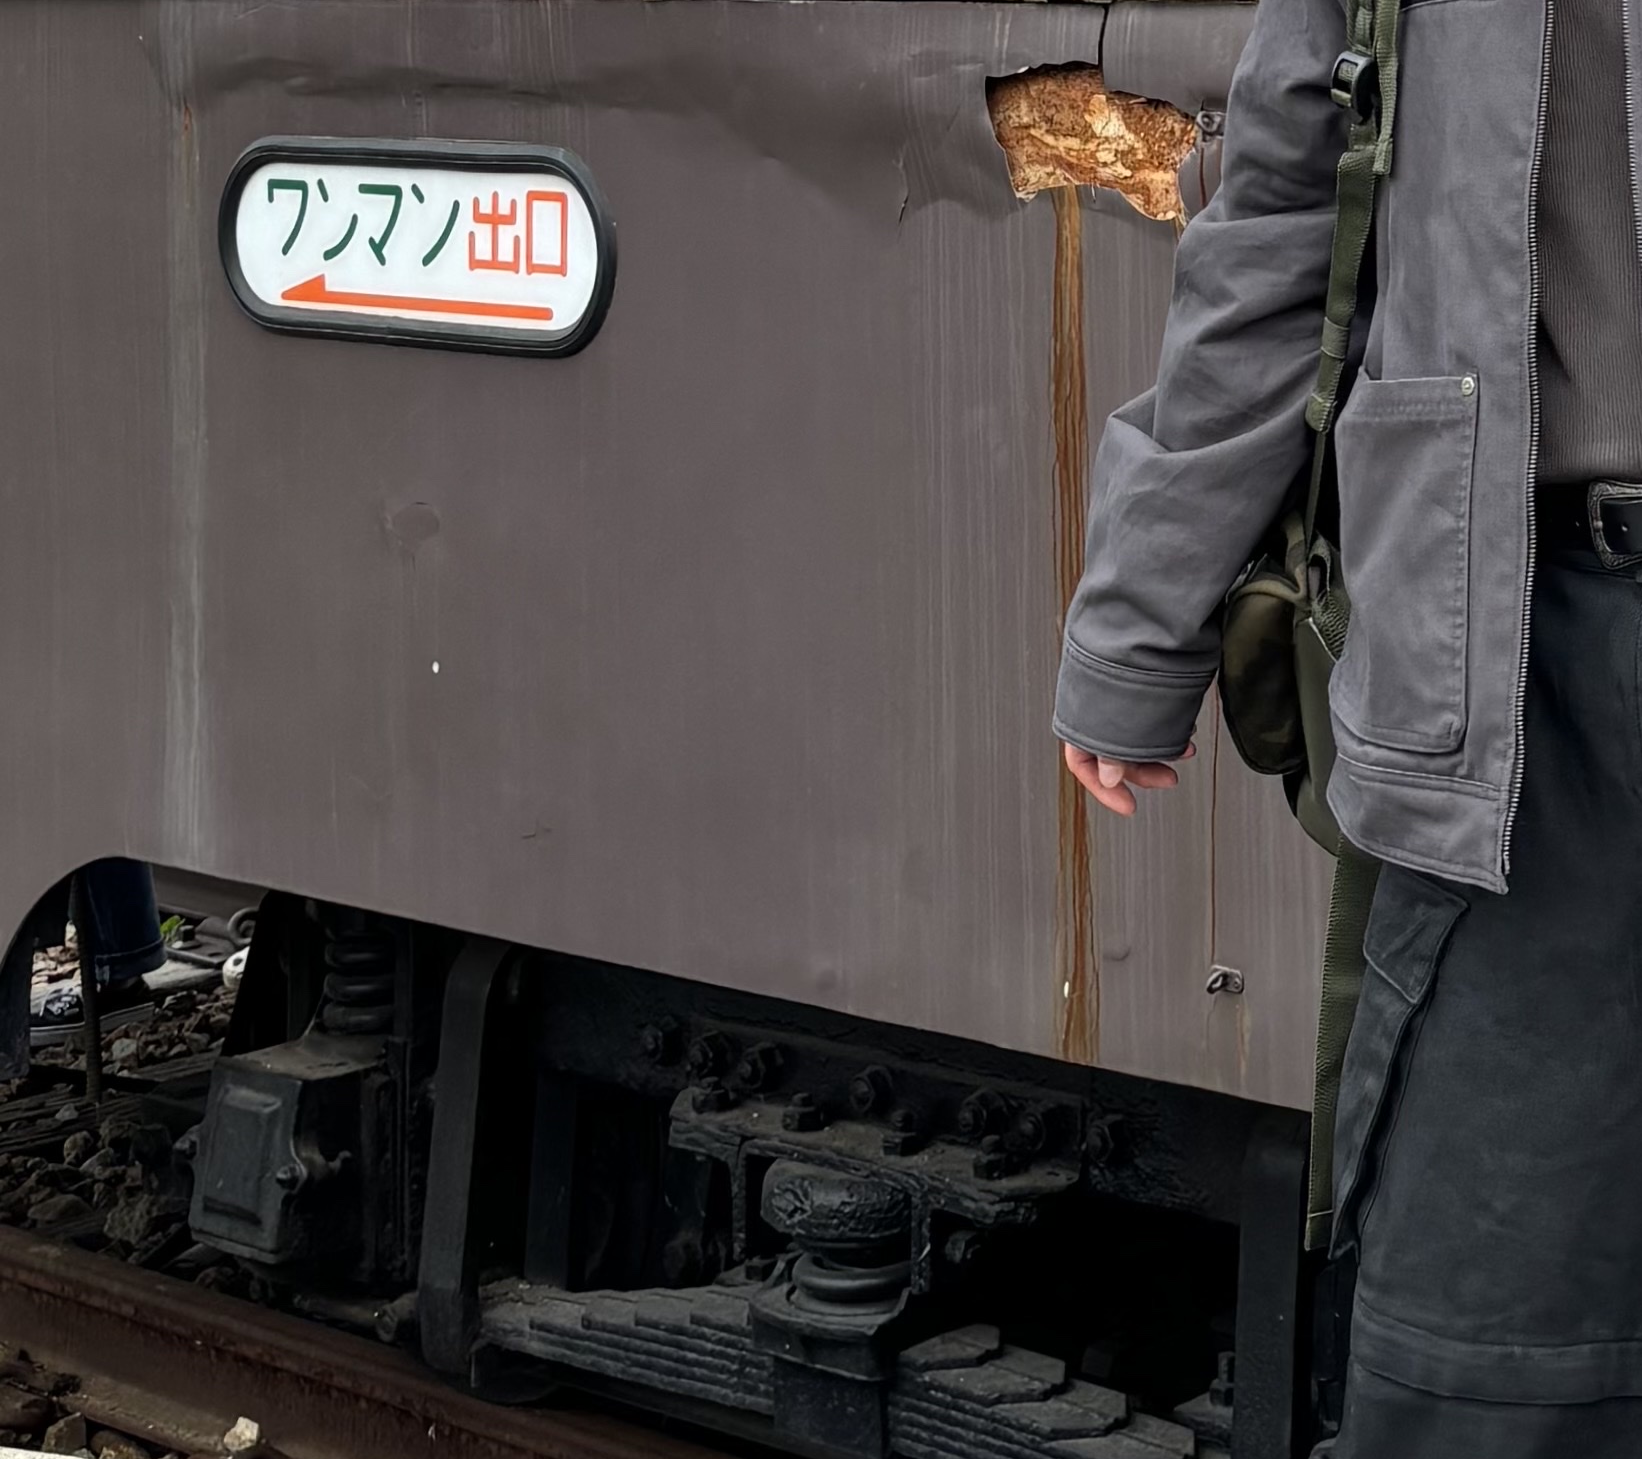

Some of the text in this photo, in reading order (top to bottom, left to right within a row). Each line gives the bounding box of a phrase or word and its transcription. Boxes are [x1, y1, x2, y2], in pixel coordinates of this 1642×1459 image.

[266, 178, 569, 277] ワンマン出口
